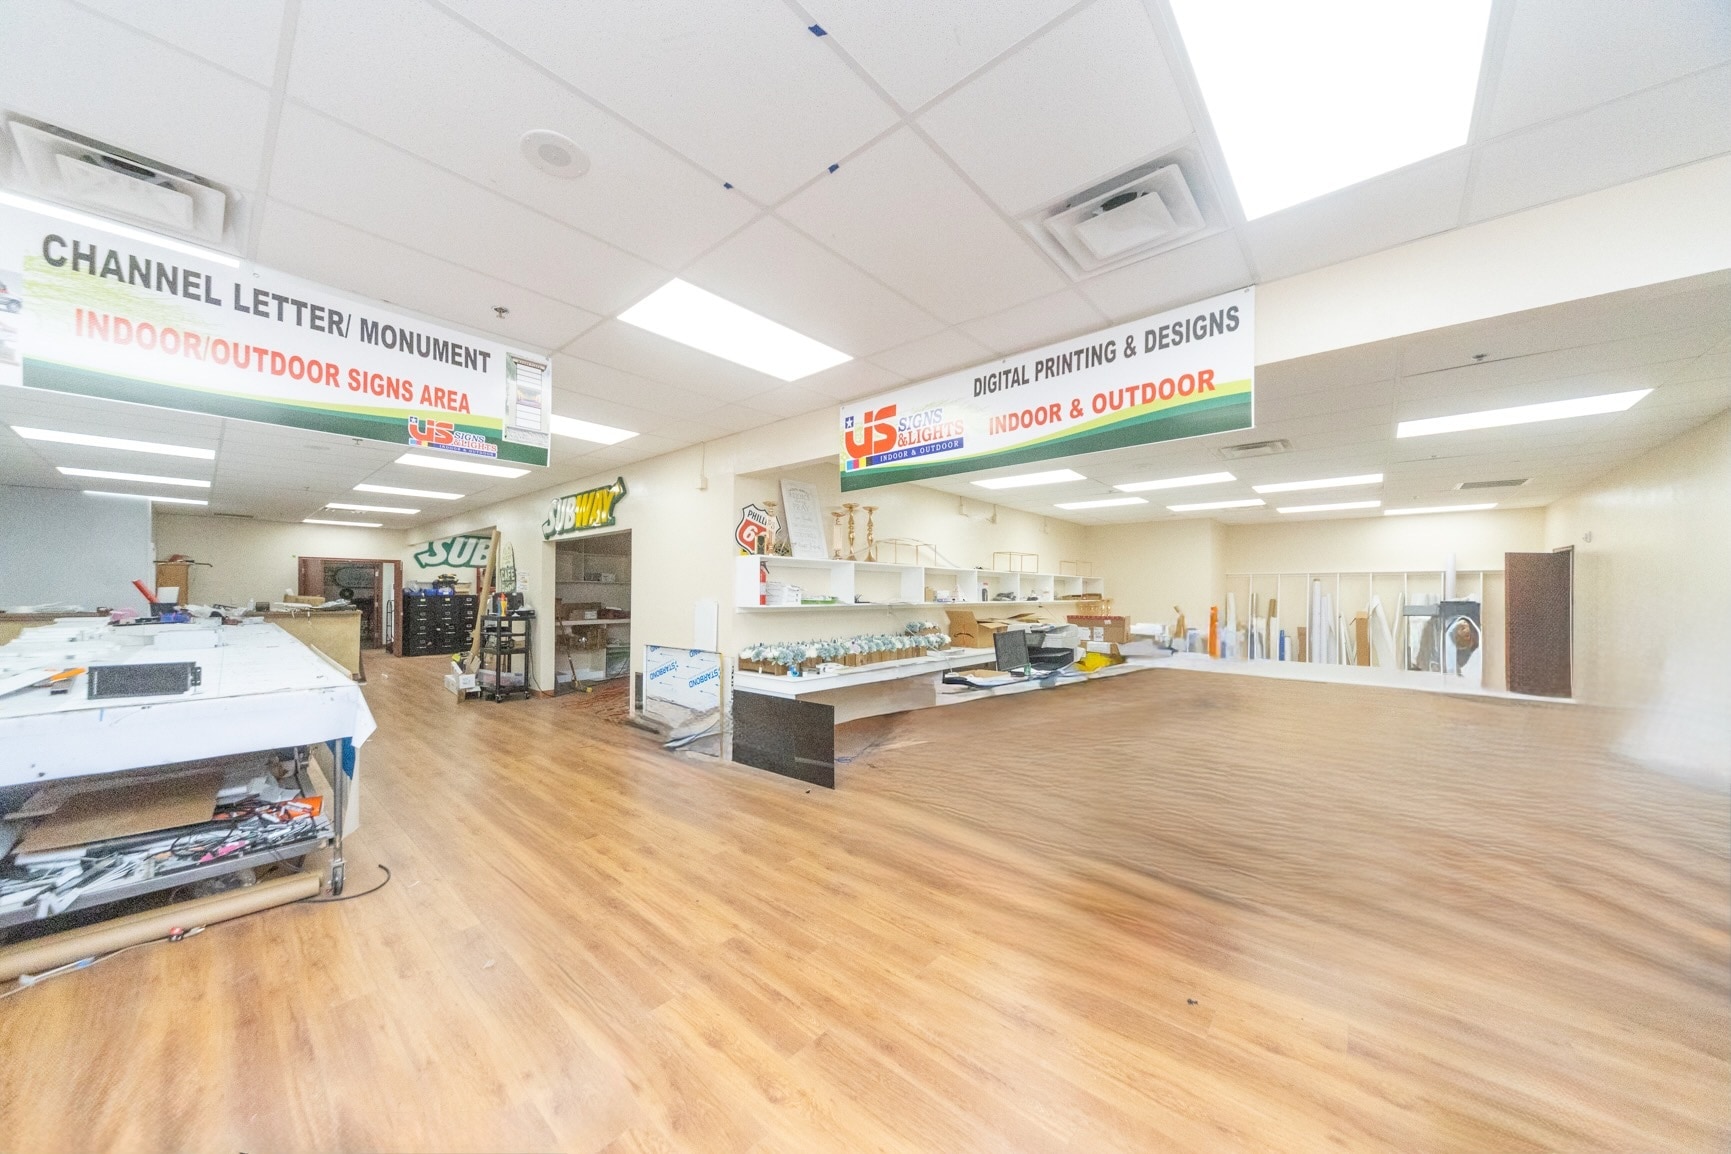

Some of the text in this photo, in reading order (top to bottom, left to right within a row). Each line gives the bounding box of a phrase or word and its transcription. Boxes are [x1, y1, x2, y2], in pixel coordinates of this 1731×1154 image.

[42, 233, 491, 374] CHANNEL LETTER/ MONUMENT
[75, 308, 470, 415] INDOOR/OUTDOOR SIGNS AREA
[973, 305, 1240, 398] DIGITAL PRINTING & DESIGNS
[898, 408, 943, 432] SIGNS
[989, 369, 1215, 436] INDOOR & OUTDOOR
[454, 432, 484, 442] SIGNS
[880, 450, 908, 462] INDOOR
[920, 440, 959, 454] OUTDOOR
[543, 478, 625, 539] SUBWAY
[649, 663, 675, 681] STARBOND
[689, 669, 719, 688] STARBOND
